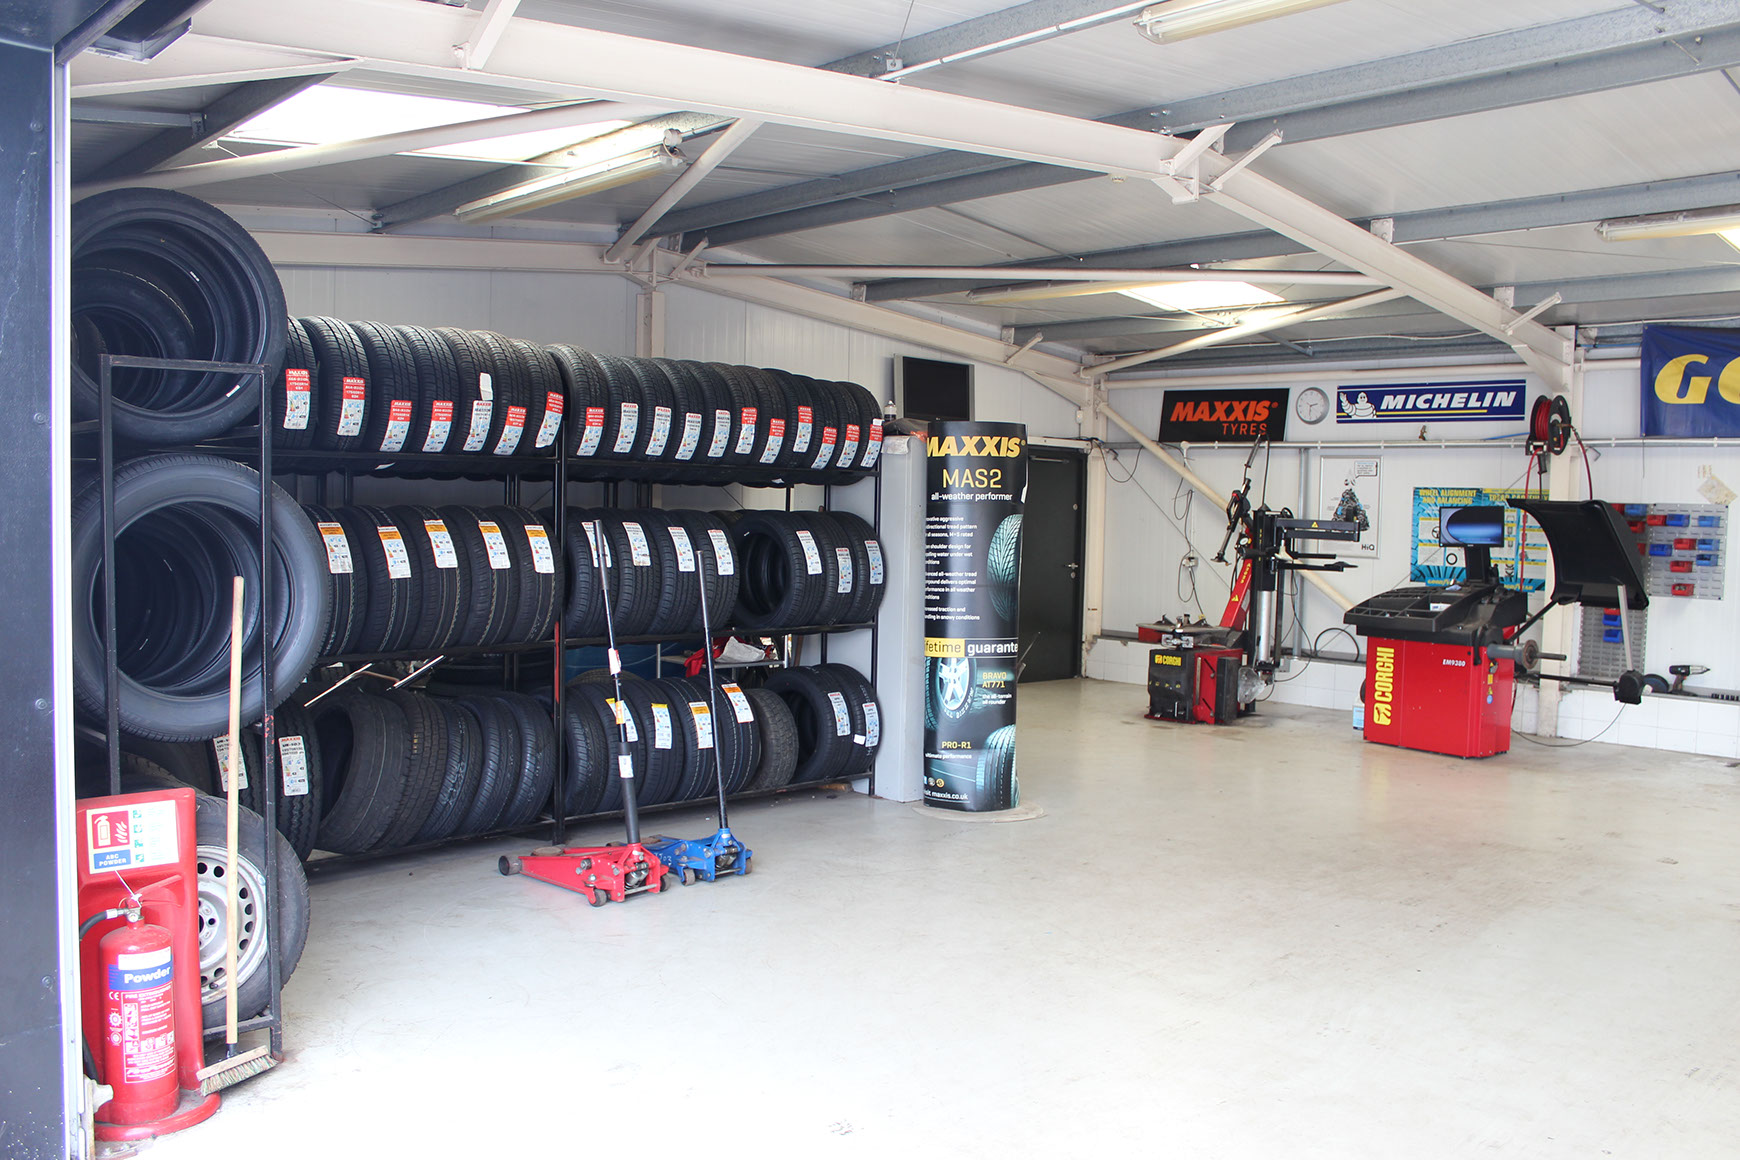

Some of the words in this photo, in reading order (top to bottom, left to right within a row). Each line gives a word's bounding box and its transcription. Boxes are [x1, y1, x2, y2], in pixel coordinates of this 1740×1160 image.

[1380, 391, 1516, 409] MICHELIN
[1170, 400, 1272, 422] MAXXIS
[1222, 423, 1267, 435] TYRES
[927, 436, 1020, 458] MAXXIS
[943, 469, 1002, 488] MAS2
[931, 492, 975, 501] all-weather
[975, 493, 1012, 502] performer
[1374, 647, 1394, 702] CORGHI
[932, 792, 968, 800] maxxis.co.uk
[99, 858, 126, 866] POWDER
[124, 967, 170, 983] Powder
